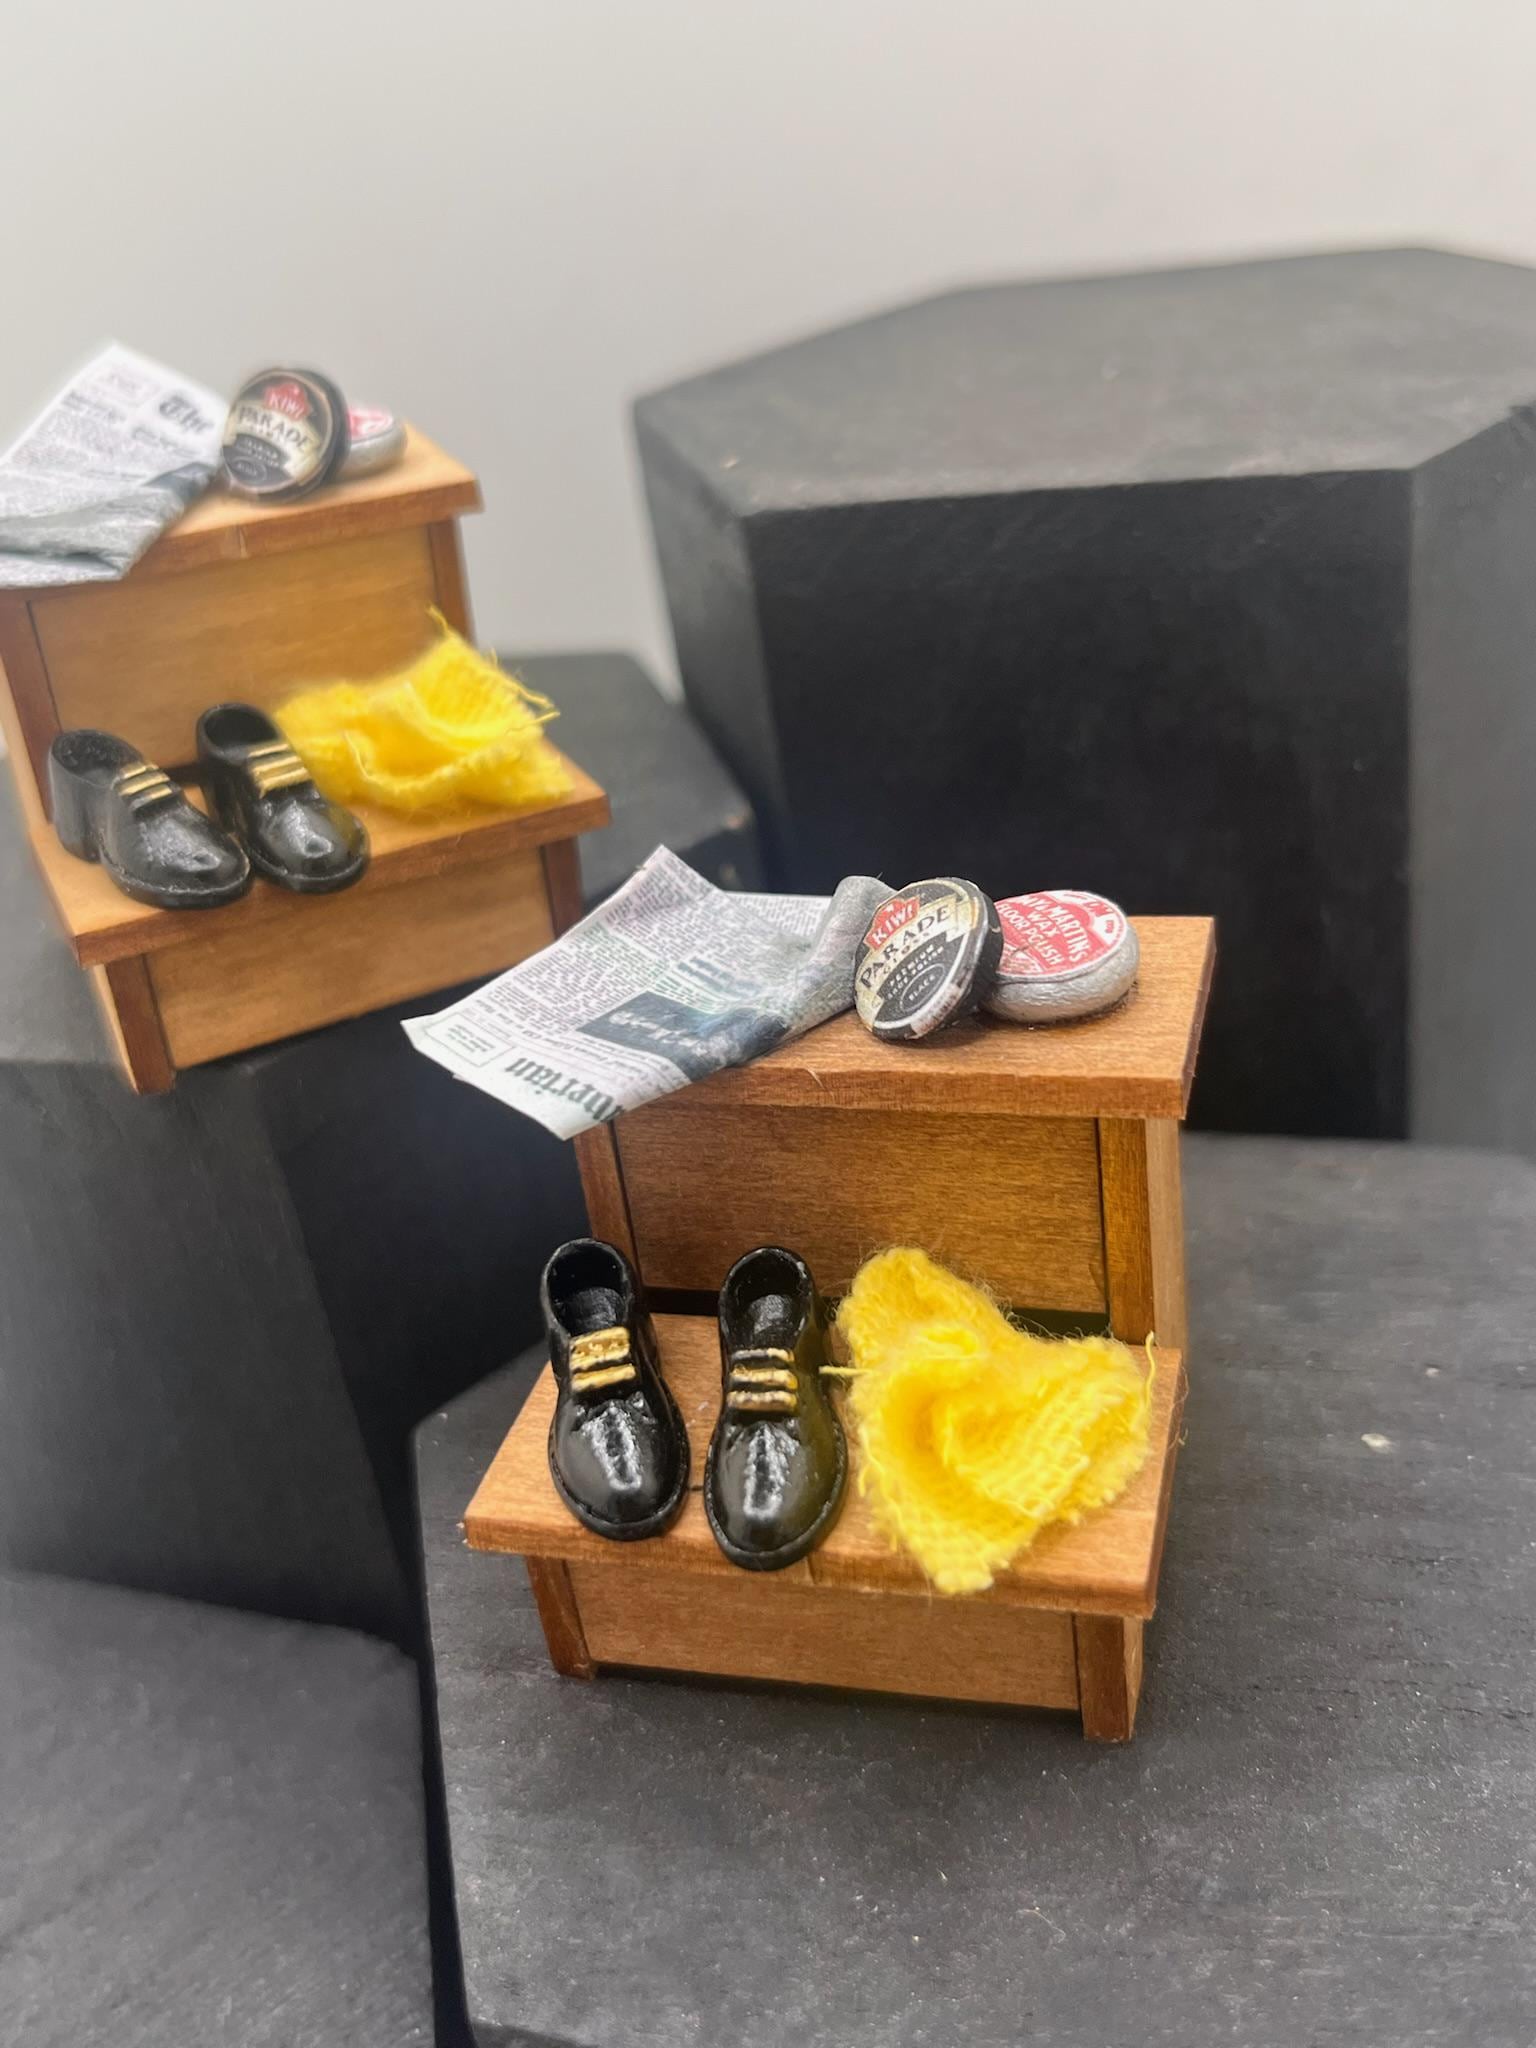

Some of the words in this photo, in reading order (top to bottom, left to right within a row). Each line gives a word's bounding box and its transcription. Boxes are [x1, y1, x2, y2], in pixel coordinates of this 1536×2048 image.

[268, 391, 305, 420] KIWI
[871, 904, 913, 945] KIWI
[1026, 911, 1061, 937] WAX
[860, 904, 951, 988] PARADE
[1024, 927, 1065, 965] POLISH
